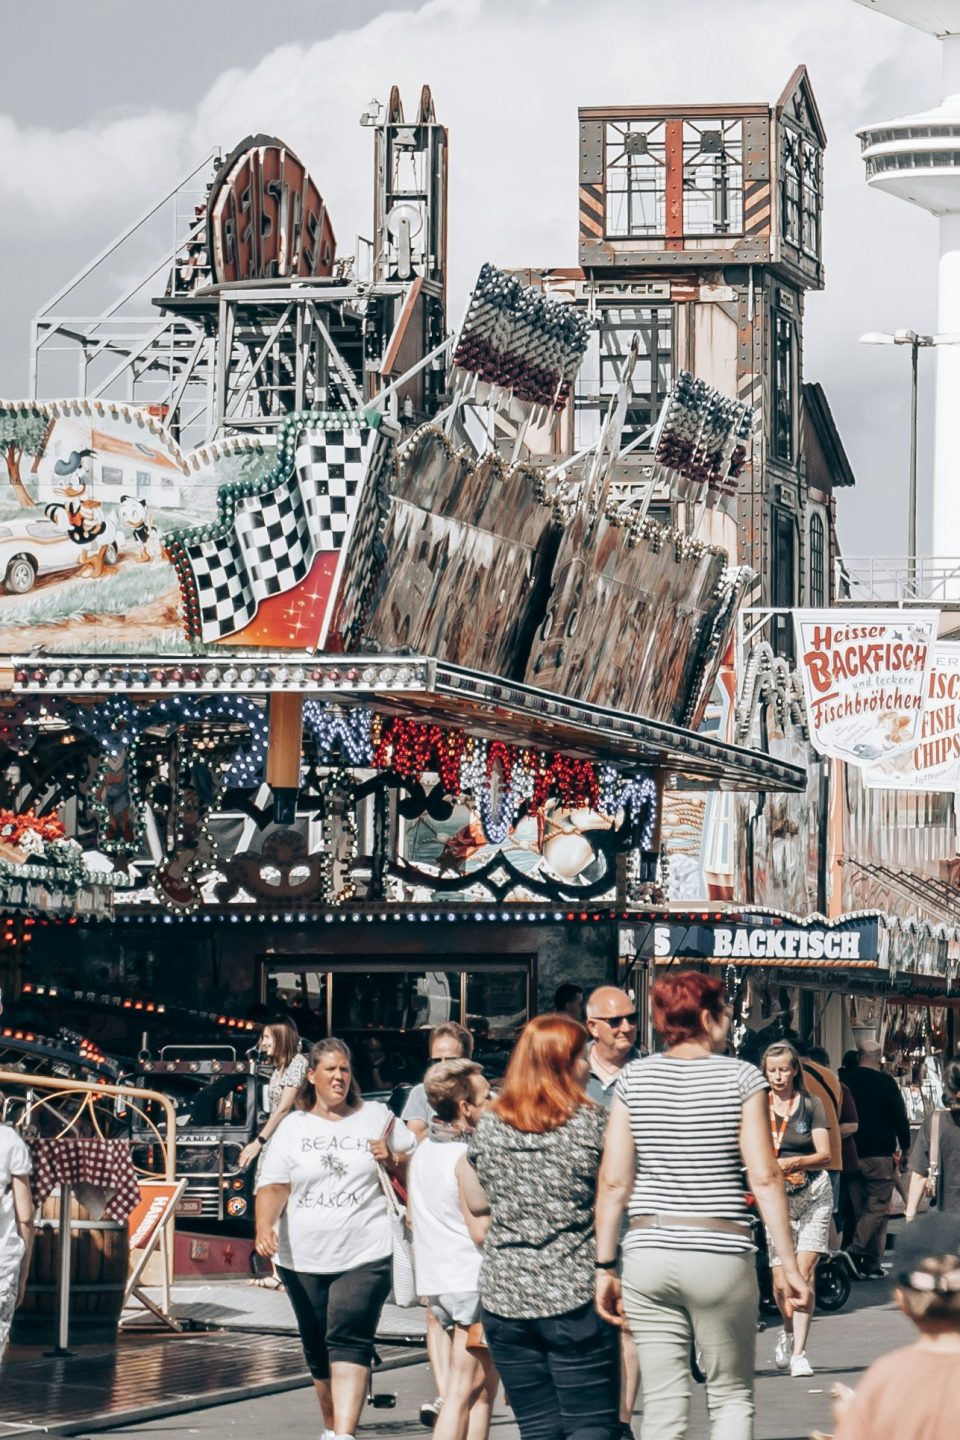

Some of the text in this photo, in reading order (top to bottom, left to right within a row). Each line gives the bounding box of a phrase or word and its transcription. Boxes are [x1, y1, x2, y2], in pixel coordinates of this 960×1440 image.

[811, 625, 886, 651] Heisser
[803, 643, 928, 693] BACKFISCH
[852, 676, 872, 691] und
[810, 687, 922, 730] Fischbrötchen
[920, 704, 956, 739] FISH
[912, 733, 960, 771] CHIPS
[713, 928, 860, 959] BACKFISCH
[301, 1136, 370, 1152] BEACH
